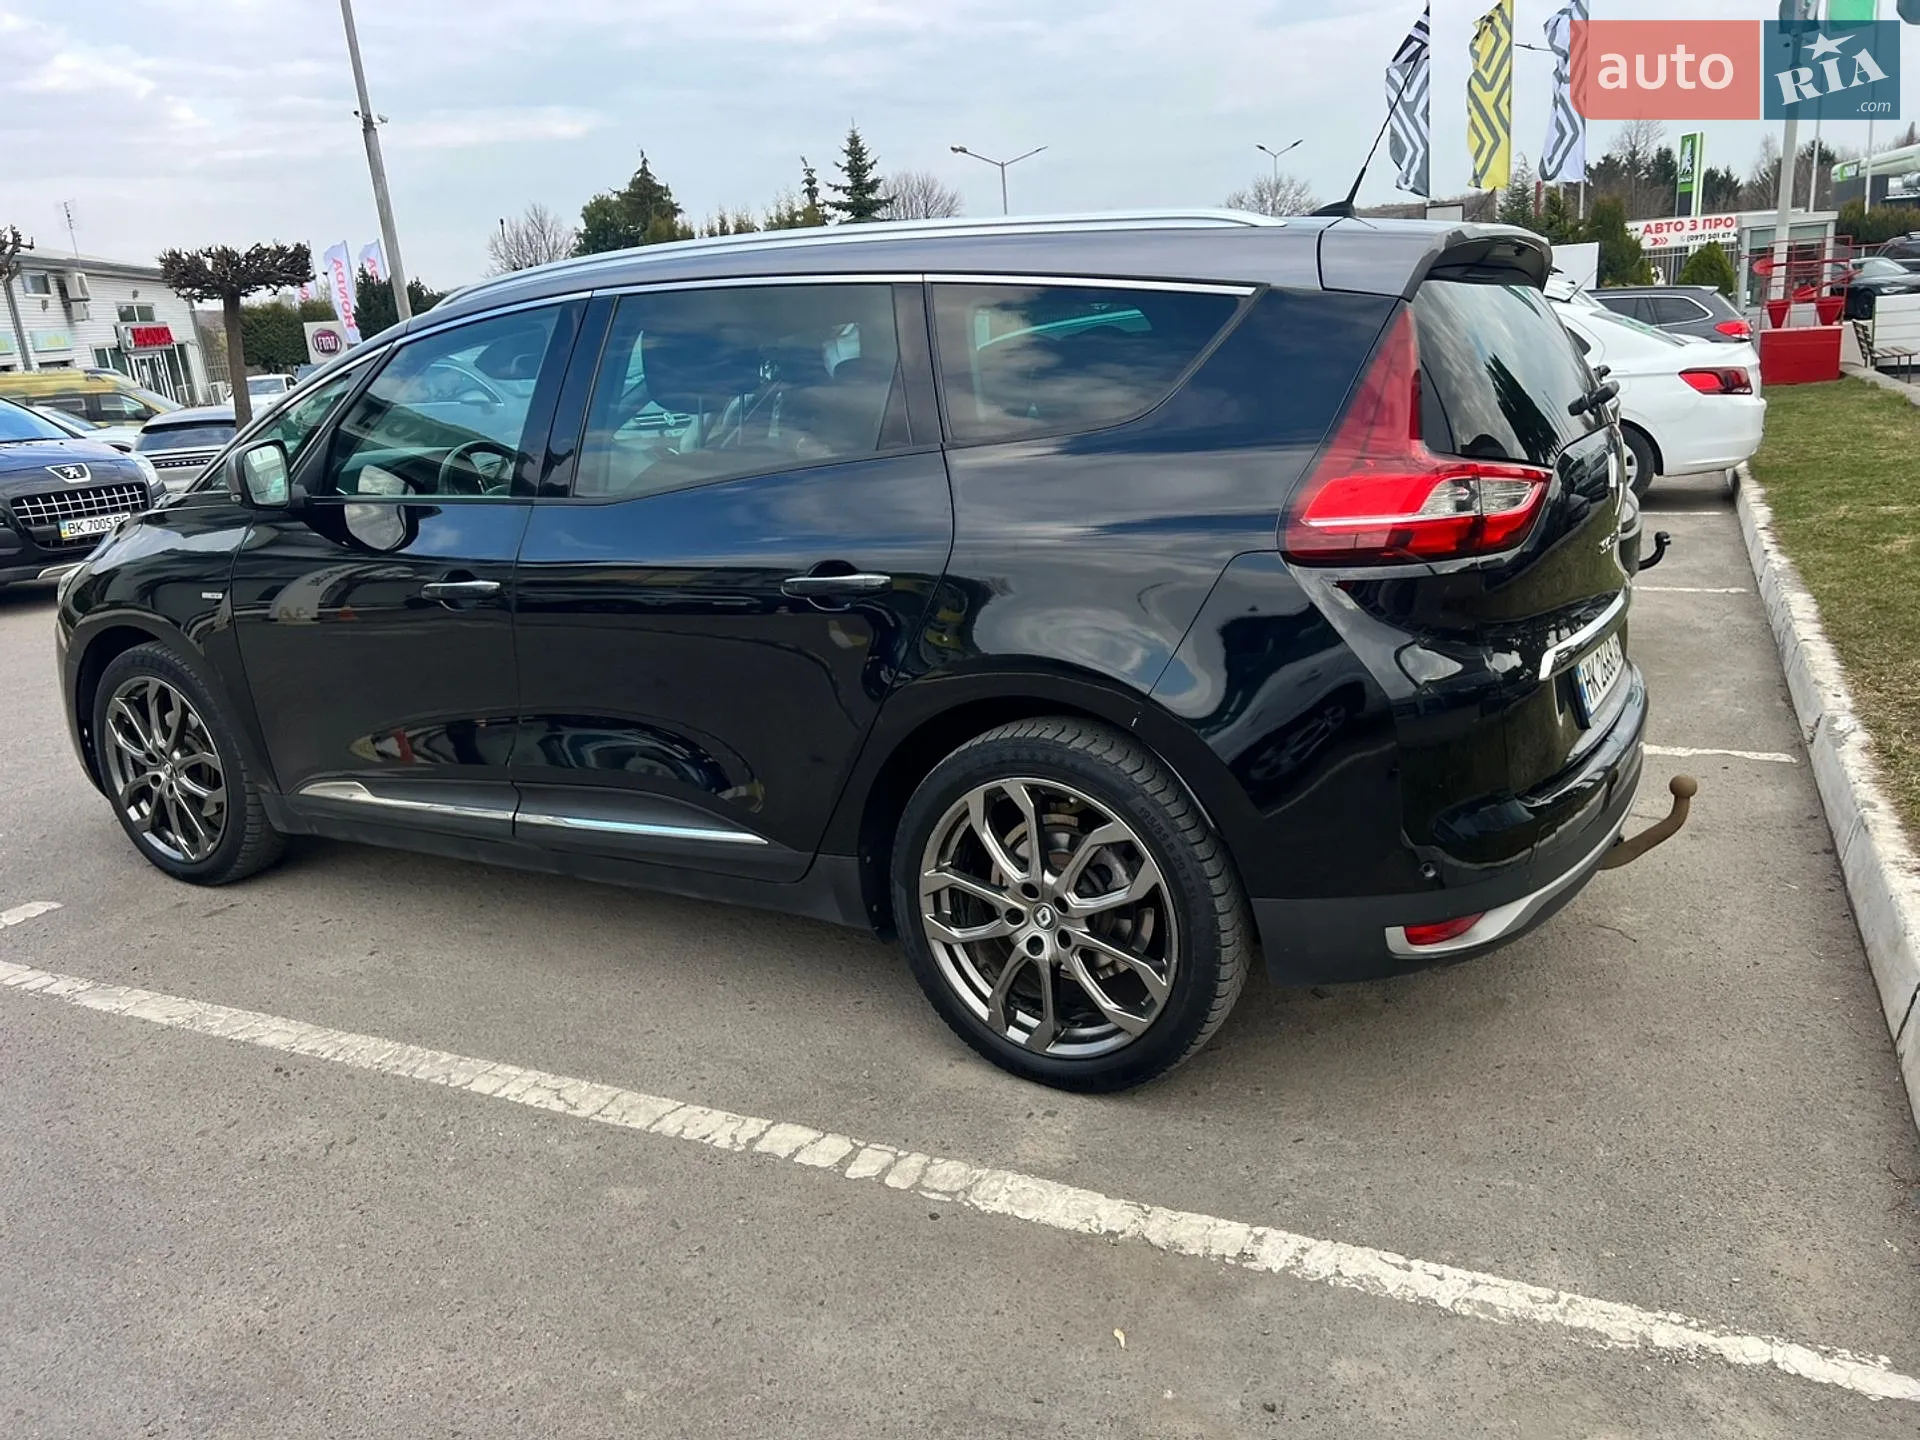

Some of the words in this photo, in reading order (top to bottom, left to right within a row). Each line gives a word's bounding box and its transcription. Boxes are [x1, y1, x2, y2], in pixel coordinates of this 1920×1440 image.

[1642, 220, 1685, 235] АВТО
[67, 521, 85, 535] BK
[86, 517, 112, 532] 7005
